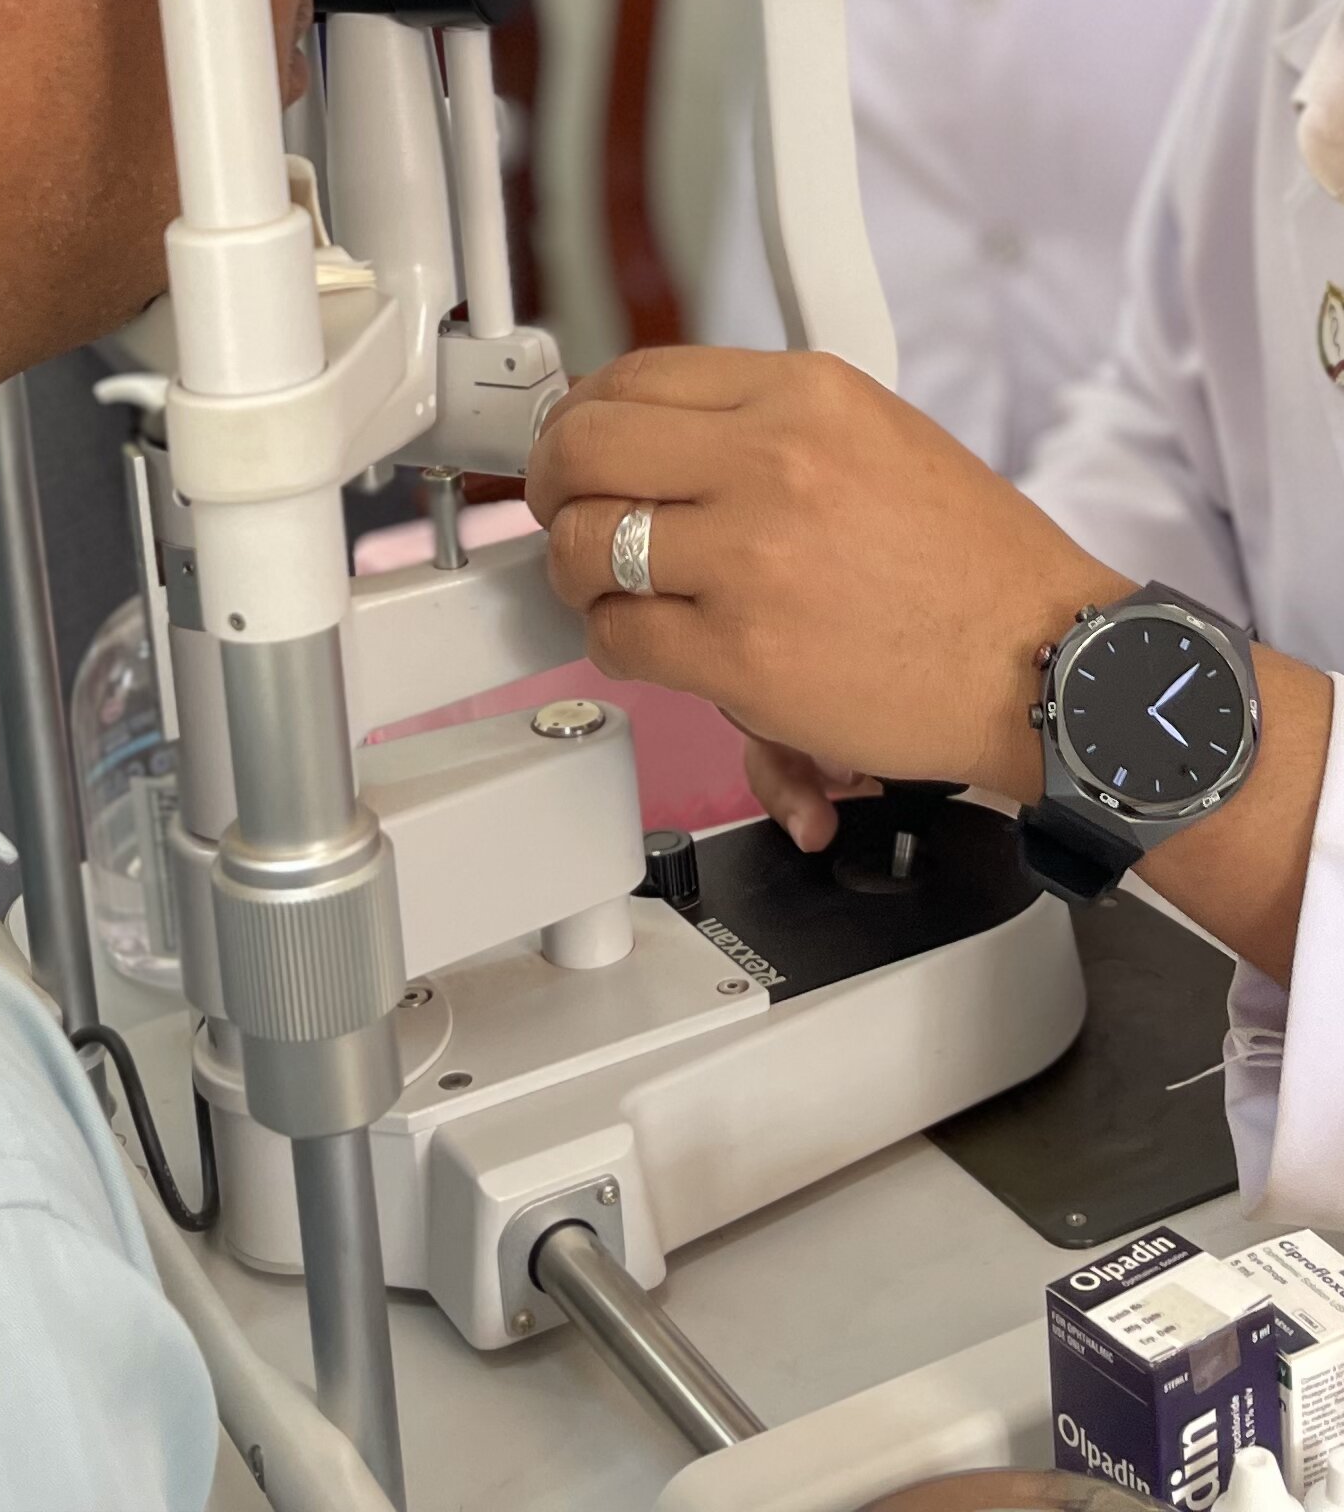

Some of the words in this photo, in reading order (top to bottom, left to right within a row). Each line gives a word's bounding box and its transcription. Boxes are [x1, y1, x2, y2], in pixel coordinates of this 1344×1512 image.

[696, 917, 787, 987] Rexxam
[1069, 1235, 1177, 1291] Olpadin
[1230, 1259, 1242, 1268] 5
[1247, 1251, 1263, 1266] Eye
[1262, 1264, 1289, 1286] Drops
[1056, 1412, 1152, 1497] Olpadin
